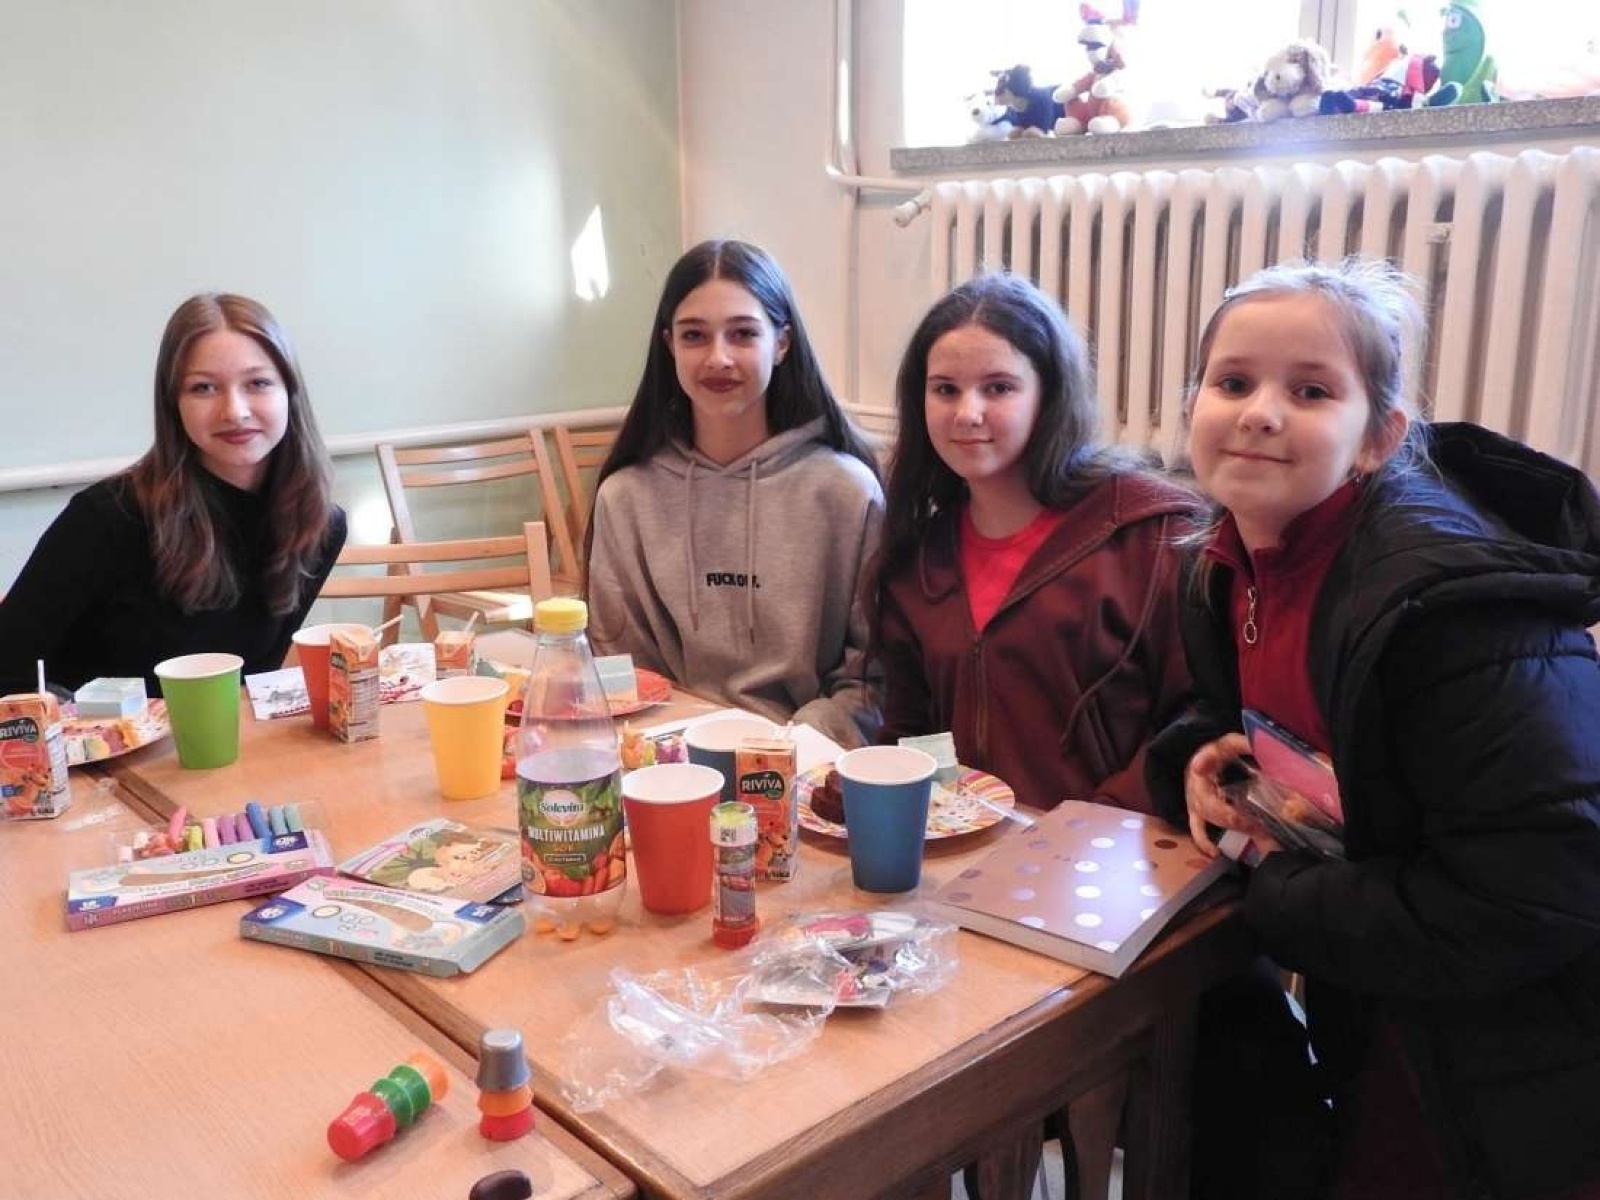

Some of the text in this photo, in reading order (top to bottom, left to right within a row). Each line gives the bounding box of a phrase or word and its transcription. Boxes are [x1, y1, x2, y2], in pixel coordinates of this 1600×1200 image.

[706, 572, 736, 586] FUCK
[741, 778, 782, 792] RIVIVA
[527, 824, 606, 842] MULTIWITAMINA
